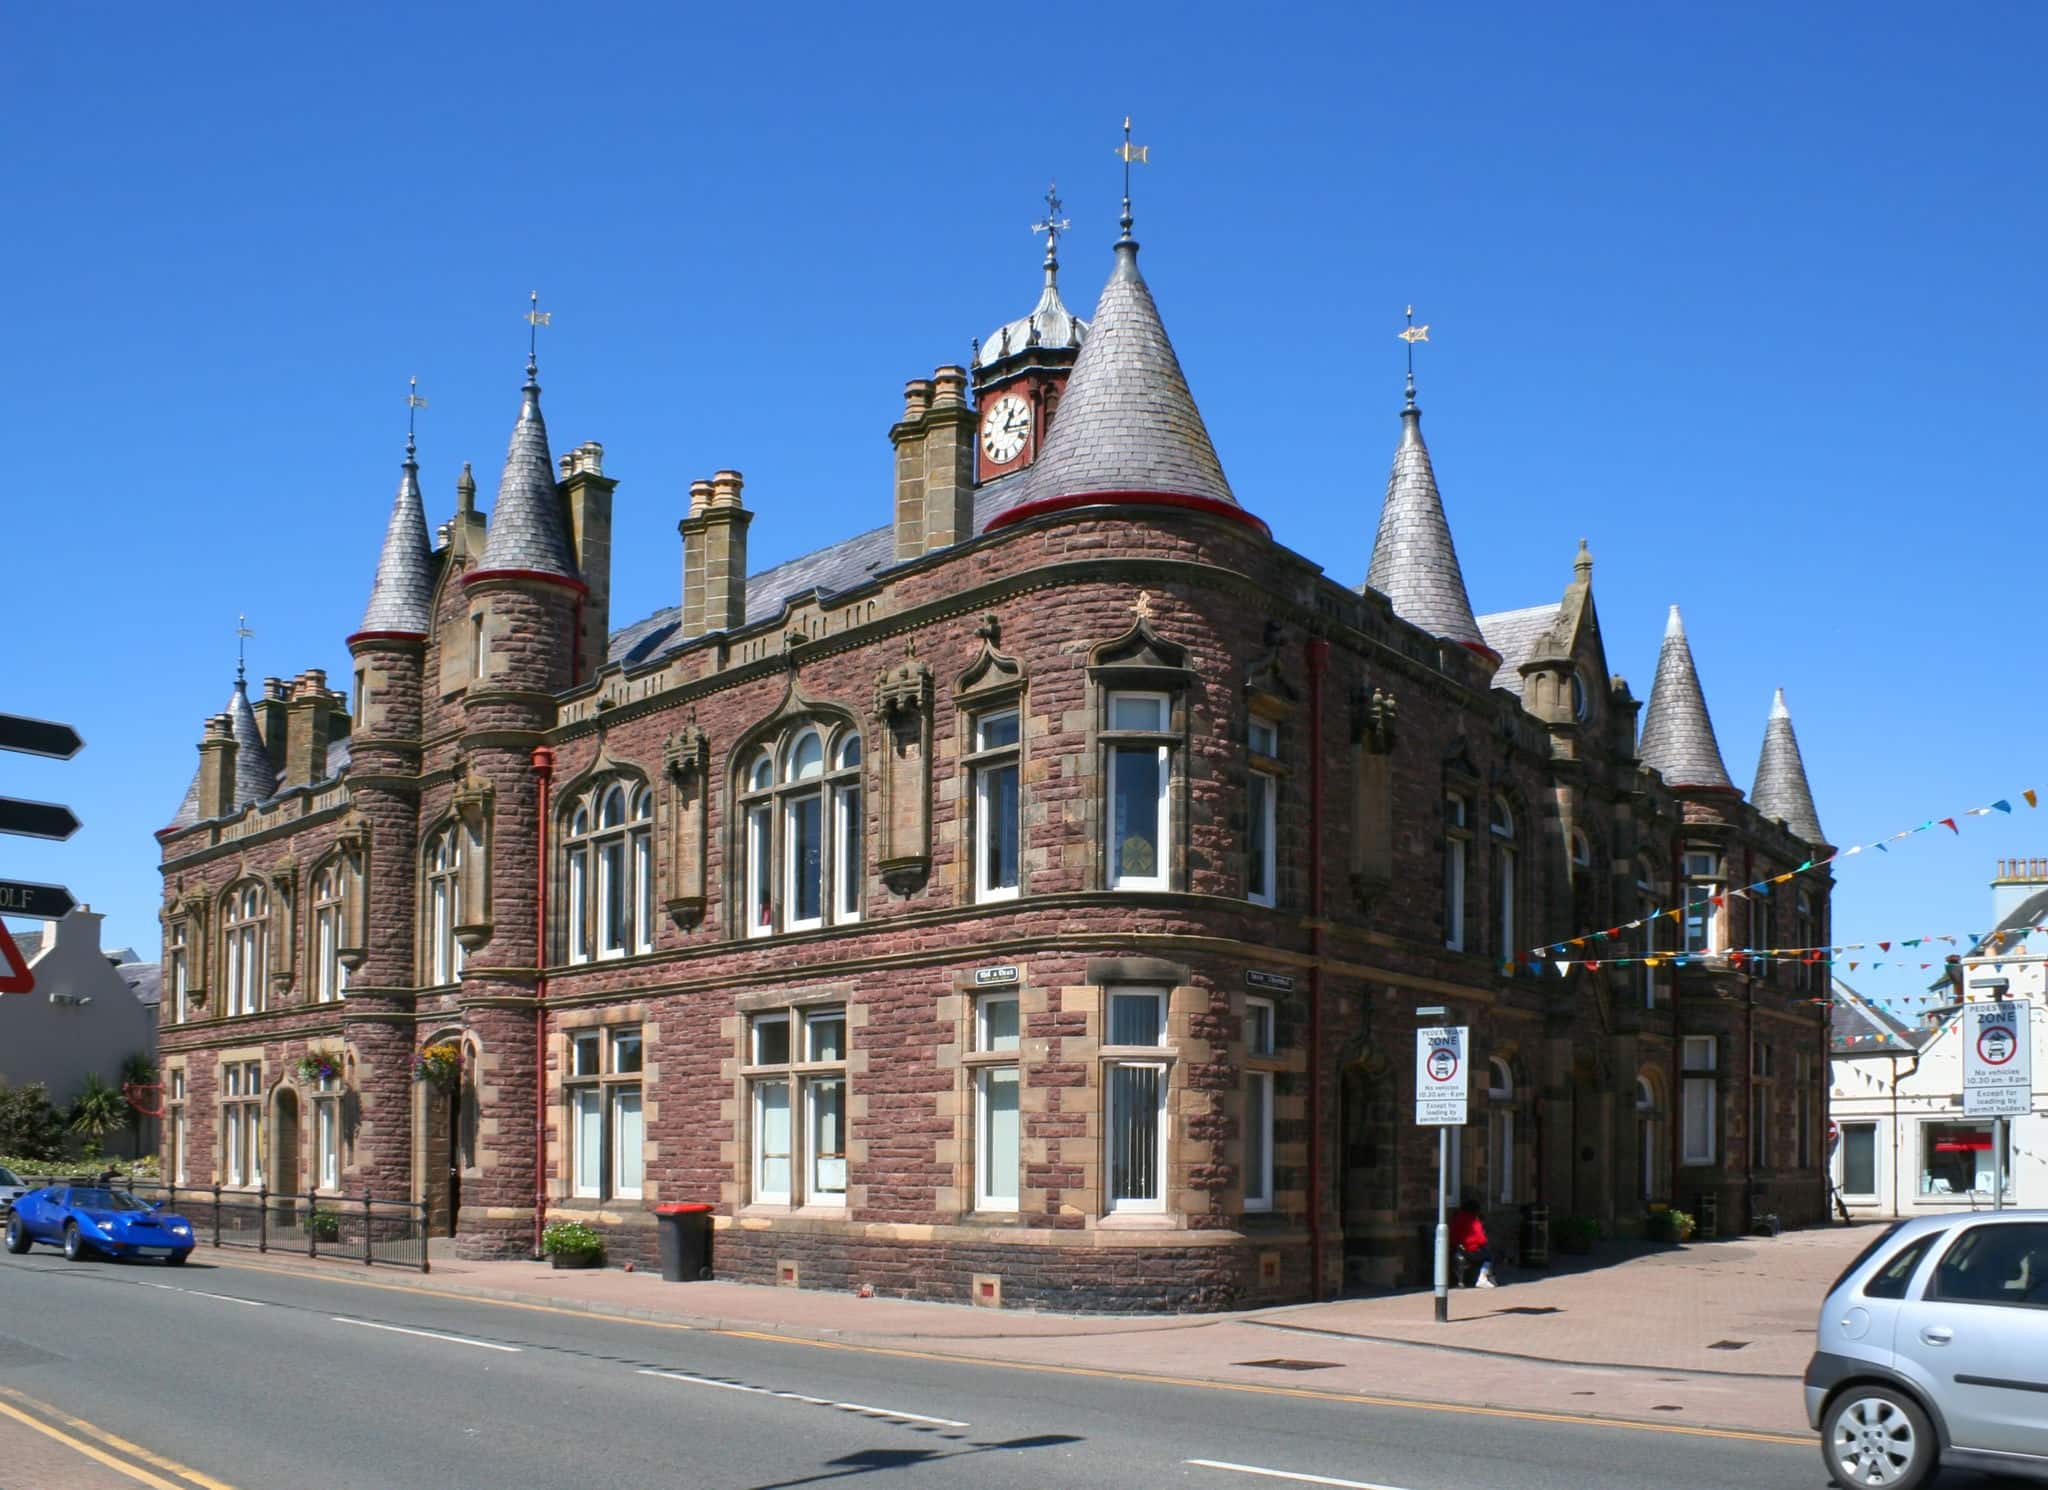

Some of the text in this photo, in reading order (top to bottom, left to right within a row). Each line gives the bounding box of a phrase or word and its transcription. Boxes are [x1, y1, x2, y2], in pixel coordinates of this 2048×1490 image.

[1968, 1002, 2023, 1012] PEDESTRIAN
[1977, 1011, 2015, 1024] ZONE
[1427, 1036, 1457, 1046] ZONE
